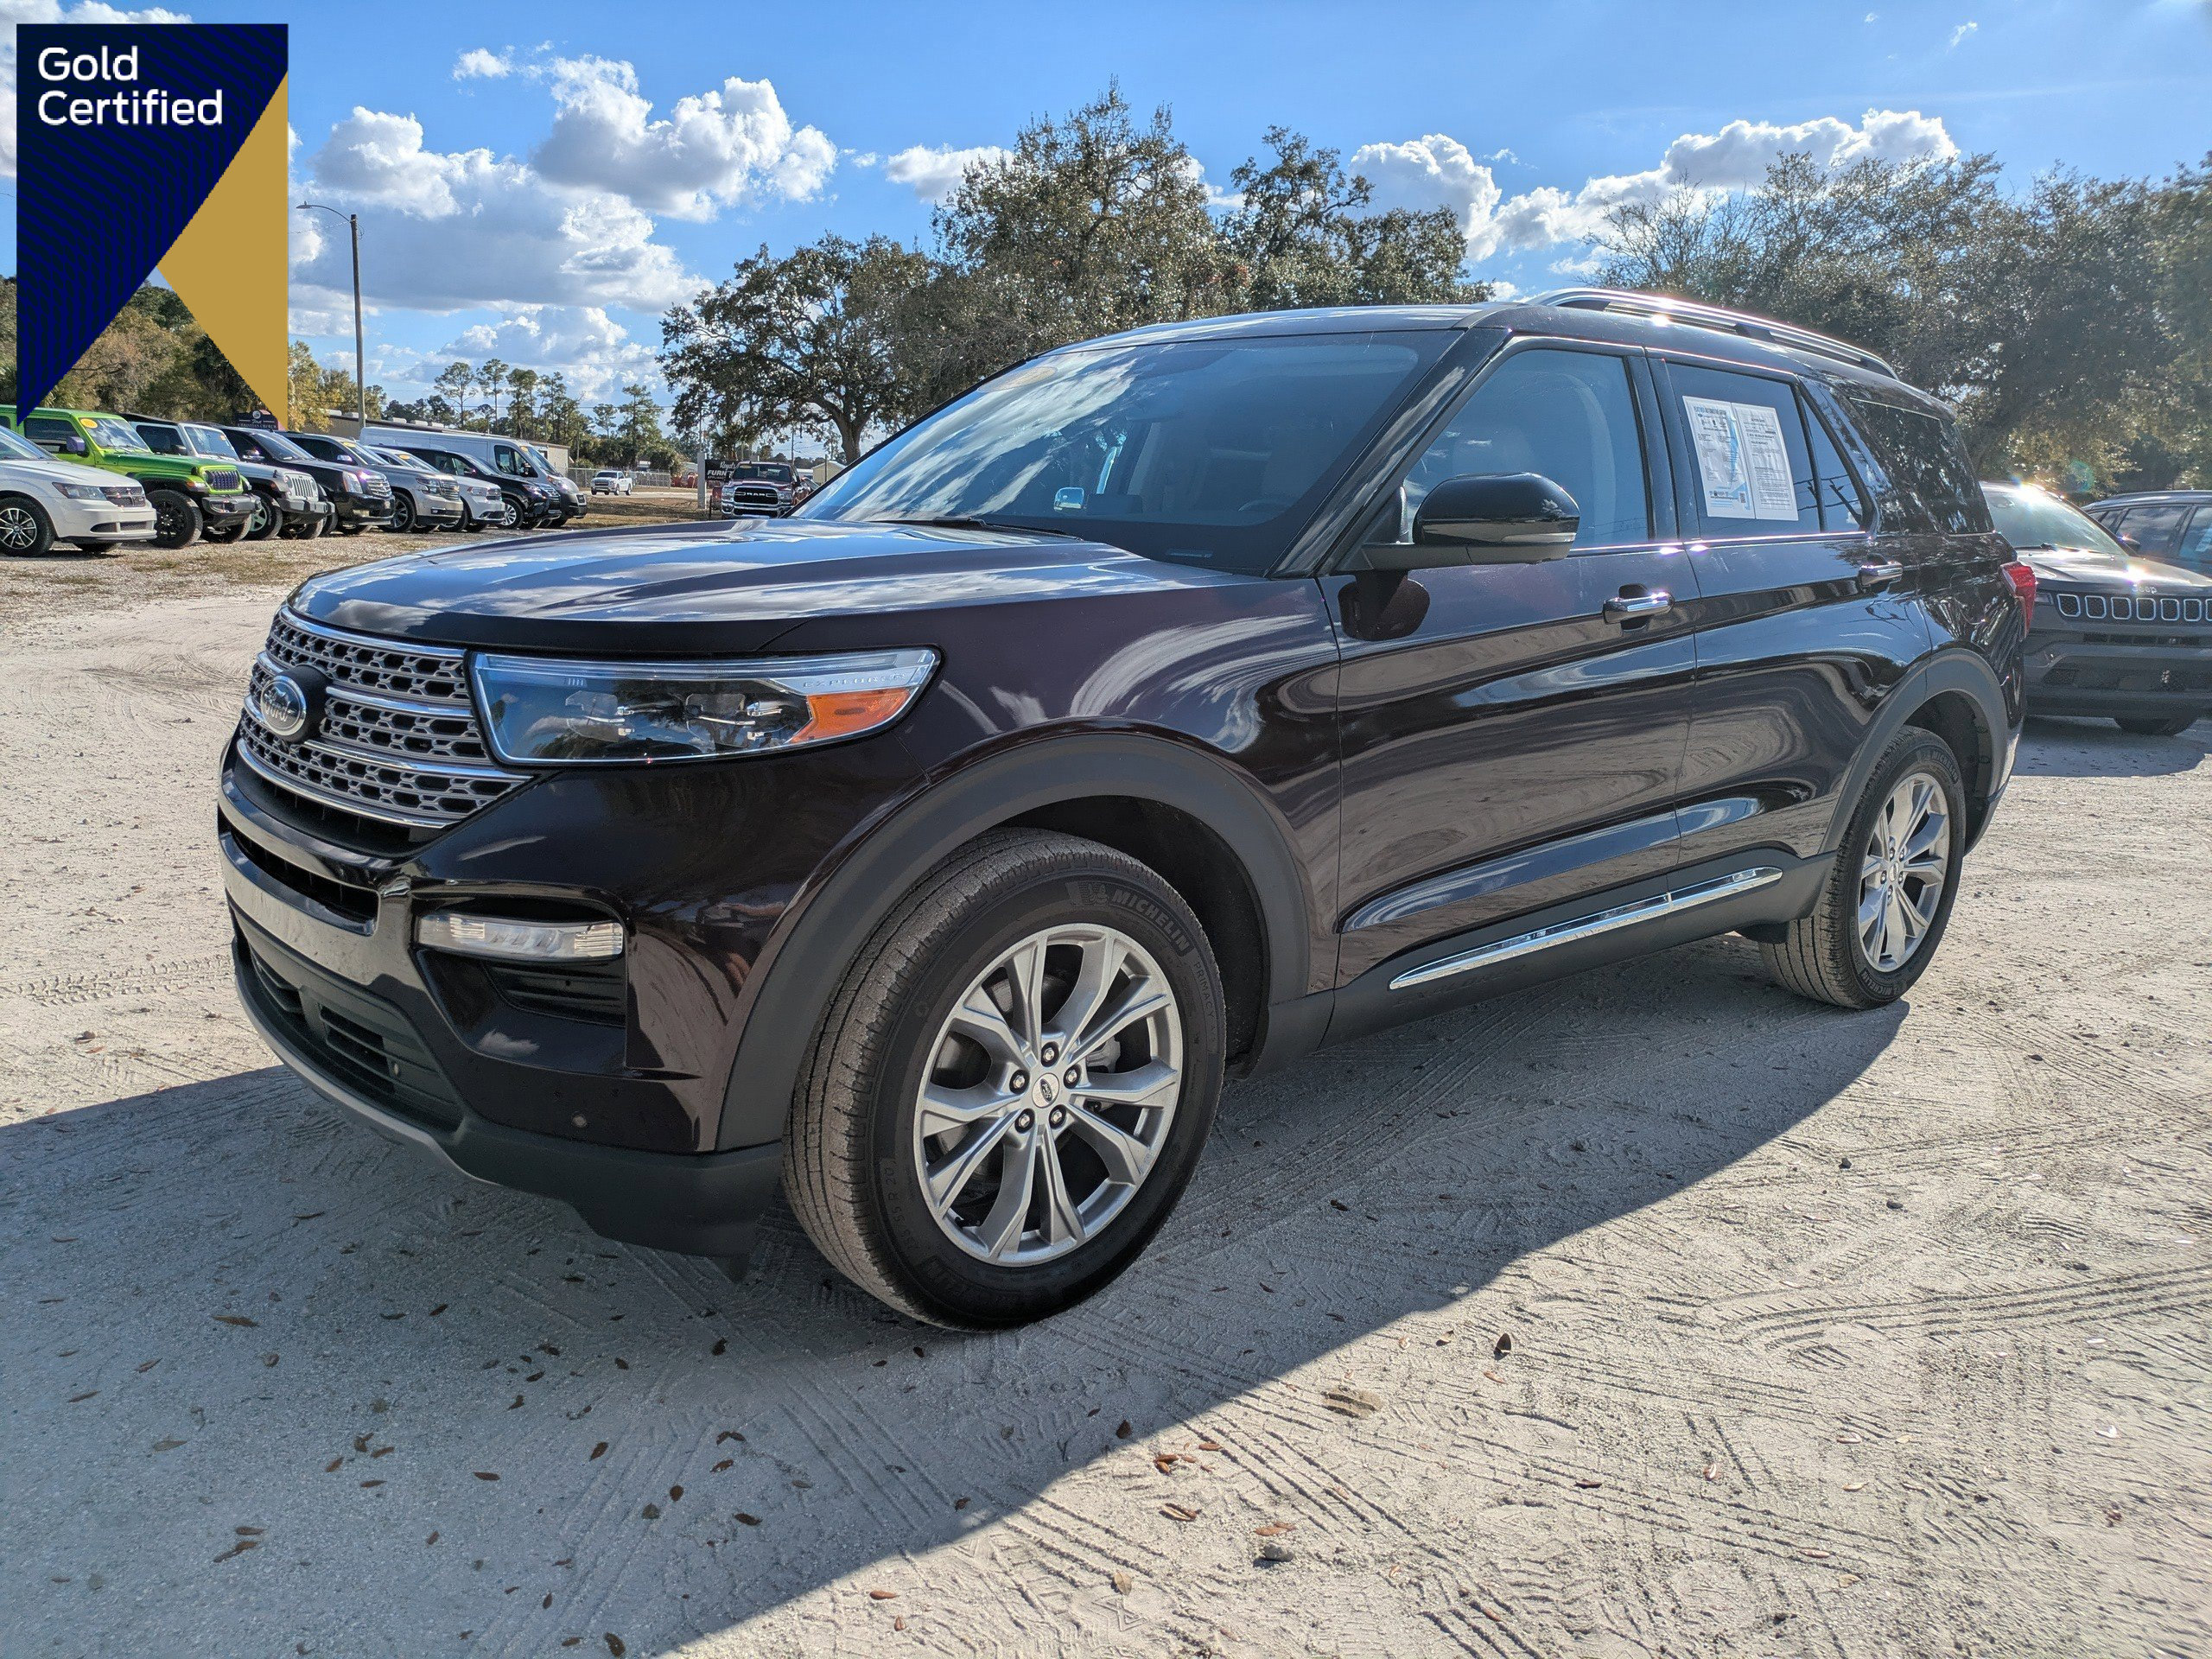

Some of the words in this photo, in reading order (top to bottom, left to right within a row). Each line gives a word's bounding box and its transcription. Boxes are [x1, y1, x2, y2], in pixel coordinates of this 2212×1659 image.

[708, 470, 734, 479] FURNT
[2132, 584, 2157, 594] Jeep
[803, 673, 905, 688] EXPLORER
[1111, 890, 1191, 954] MICHELIN
[1193, 961, 1216, 1019] PRIMACY
